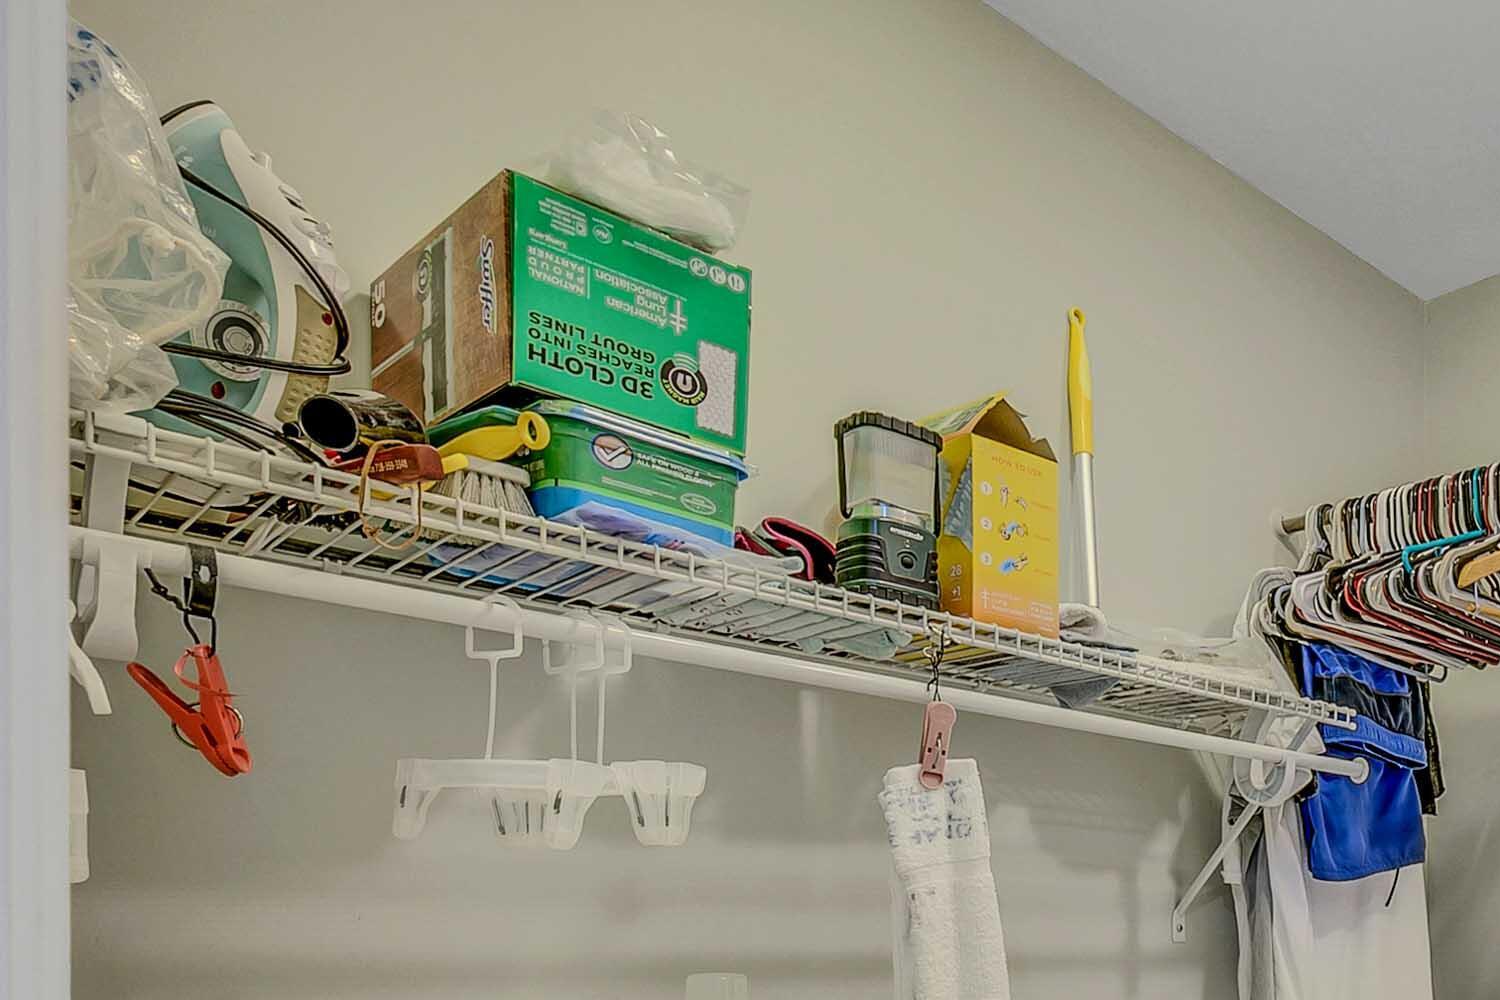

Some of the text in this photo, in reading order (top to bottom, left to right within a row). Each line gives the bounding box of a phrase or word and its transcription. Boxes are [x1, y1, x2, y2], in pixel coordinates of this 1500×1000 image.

[527, 245, 585, 274] PARTNER
[528, 268, 585, 297] NATIONAL
[374, 280, 386, 328] 50
[479, 235, 496, 334] Swiffer
[634, 294, 668, 317] Lung
[604, 296, 668, 327] American
[528, 310, 655, 364] GROUT LINES
[528, 327, 655, 379] REACHES INTO
[528, 343, 654, 399] 3D CLOTH
